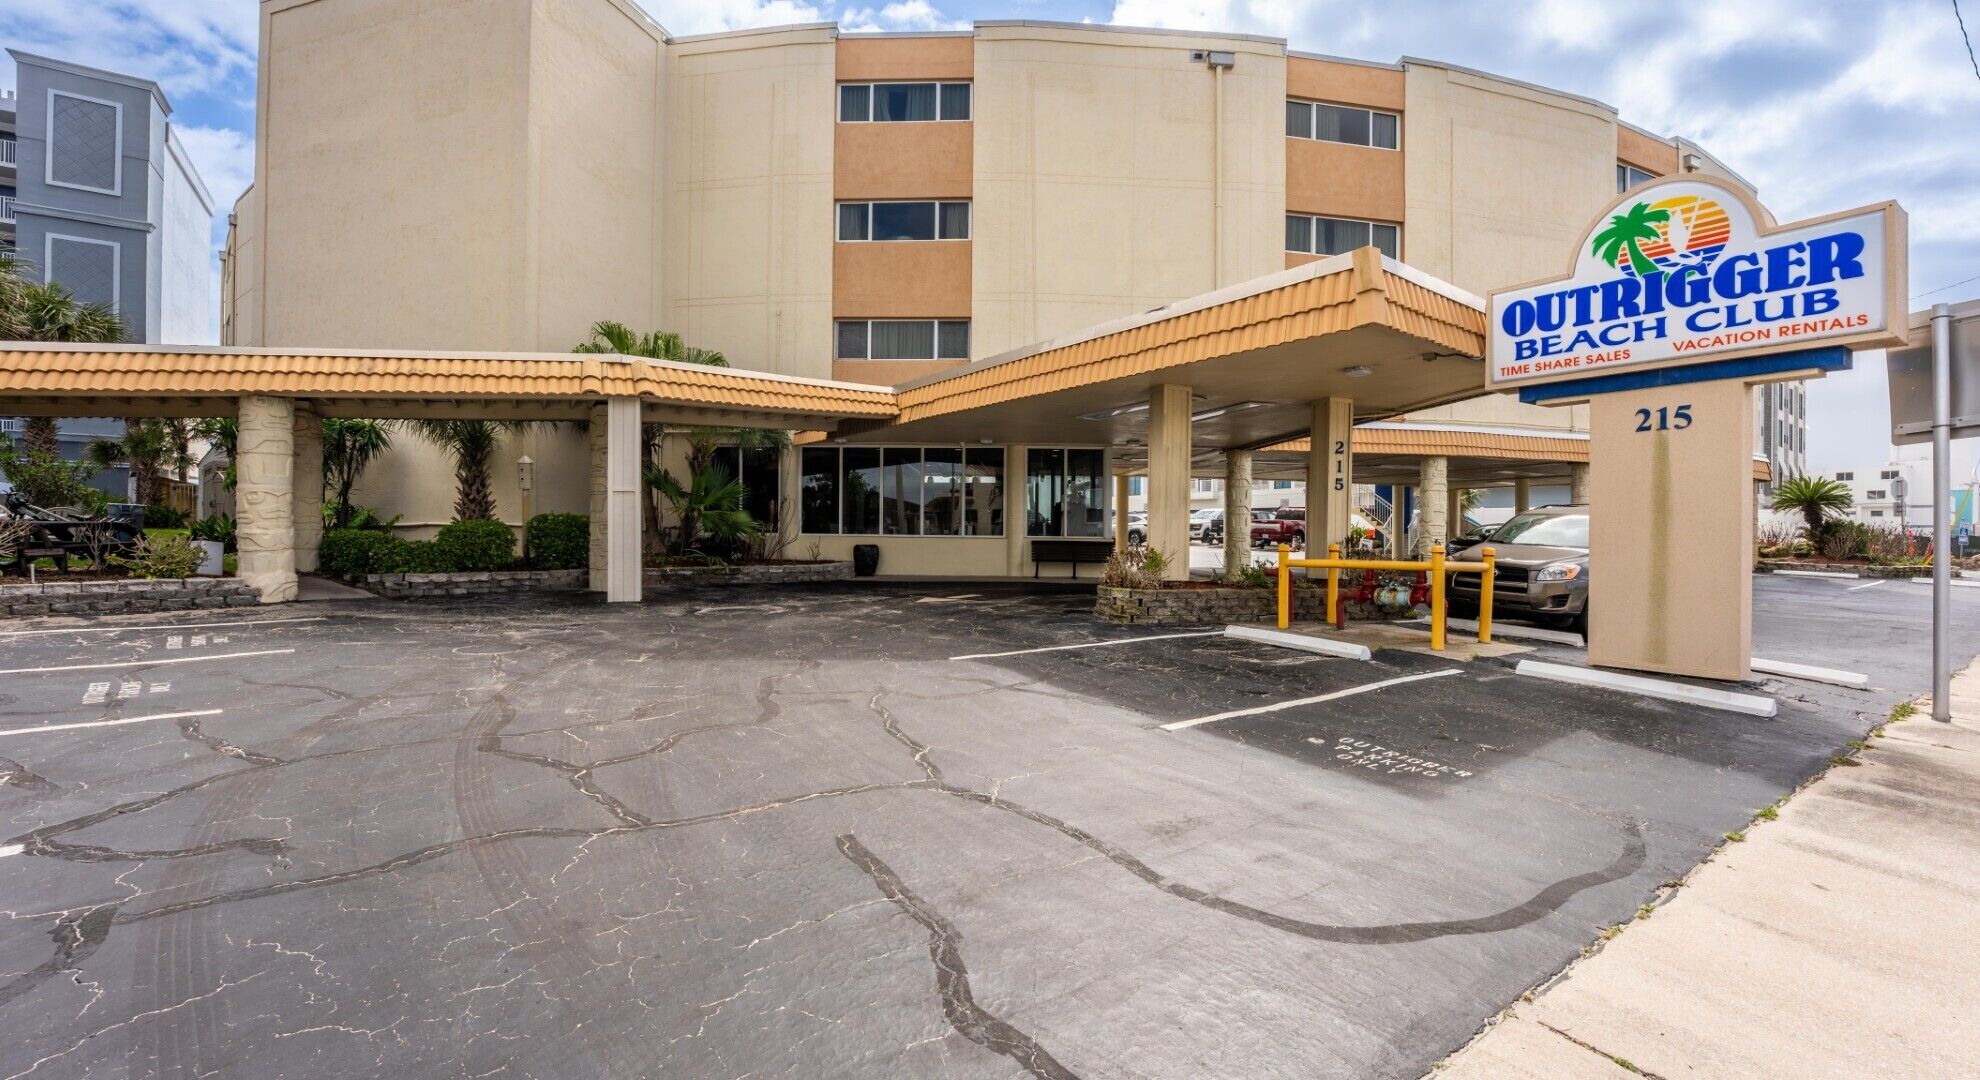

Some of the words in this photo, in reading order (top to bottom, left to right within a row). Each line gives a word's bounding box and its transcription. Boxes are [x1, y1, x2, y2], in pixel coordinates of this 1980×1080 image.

[1502, 231, 1865, 338] OUTRIGGER
[1514, 316, 1668, 362] BEACH
[1686, 288, 1841, 333] CLUB
[1672, 328, 1771, 353] VACATION
[1778, 313, 1869, 339] RENTALS
[1500, 363, 1530, 378] TIME
[1535, 355, 1581, 373] SHARE
[1586, 349, 1631, 366] SALES
[1635, 405, 1694, 433] 215
[1334, 440, 1345, 491] 215
